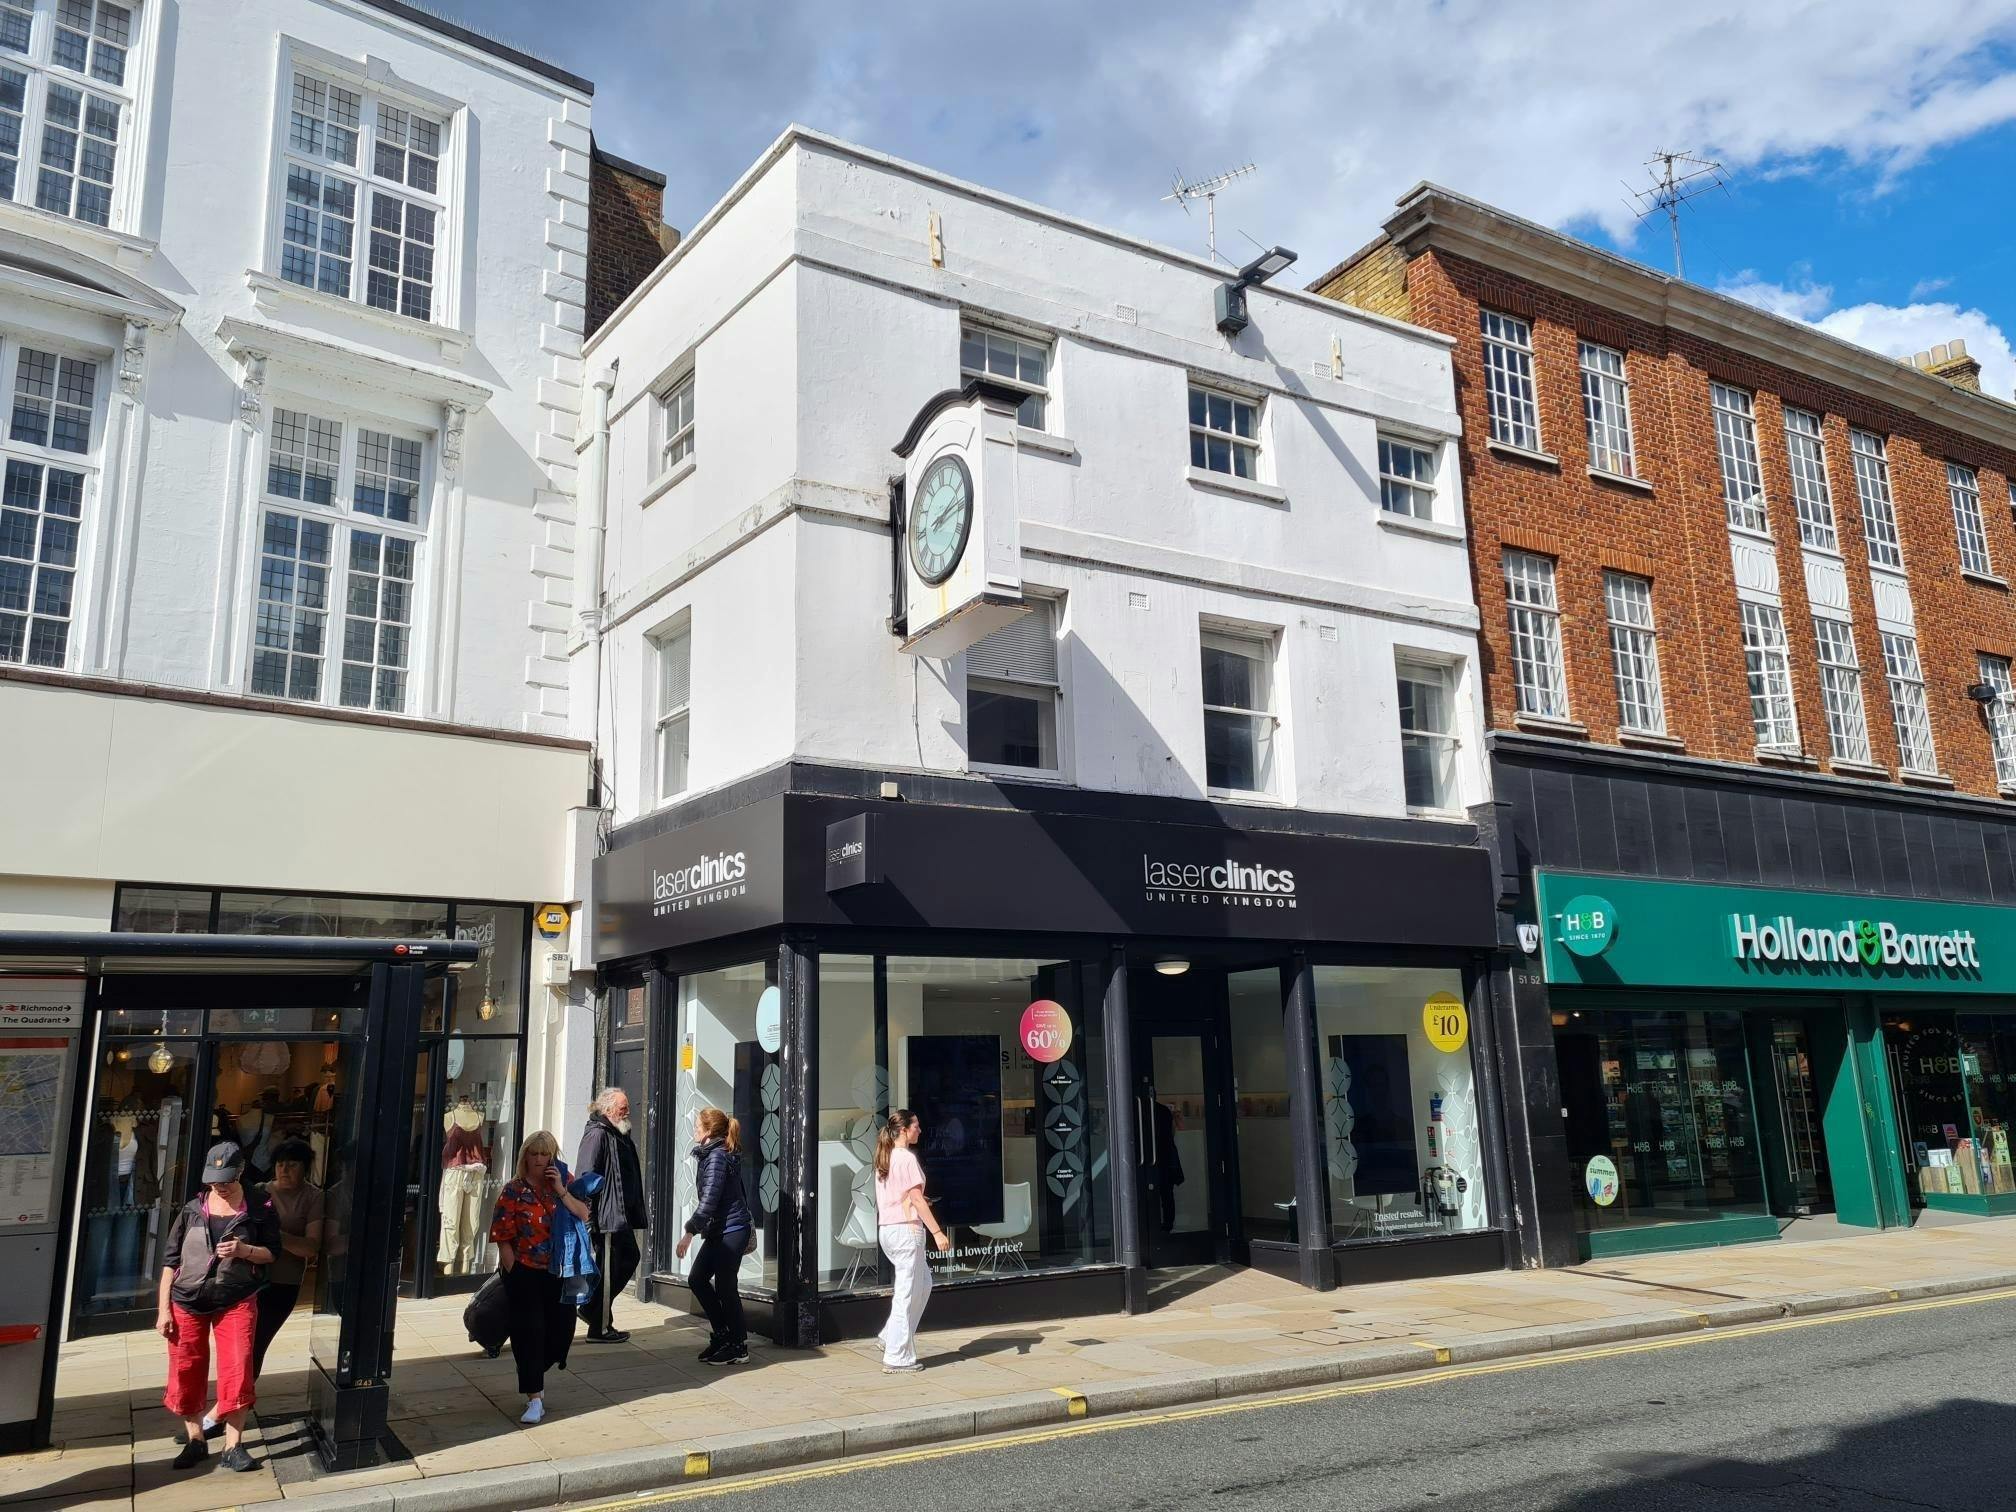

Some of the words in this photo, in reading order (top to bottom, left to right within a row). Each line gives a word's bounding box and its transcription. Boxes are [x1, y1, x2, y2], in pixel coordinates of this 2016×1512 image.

[653, 851, 746, 900] laserclinics
[1144, 853, 1296, 892] laserclinics
[653, 899, 690, 917] UNITED
[696, 884, 746, 906] KINGDOM
[1146, 892, 1209, 904] UNITED
[1223, 896, 1297, 908] KINGDOM
[546, 914, 562, 924] ADT
[1519, 975, 1528, 985] 51
[1530, 976, 1541, 985] 52
[1433, 1014, 1459, 1036] £10
[1027, 1029, 1066, 1049] 60%
[1590, 1167, 1616, 1177] summer
[1374, 1211, 1400, 1221] Trusted
[956, 1249, 963, 1258] a
[965, 1246, 992, 1257] lower
[994, 1241, 1023, 1256] price?
